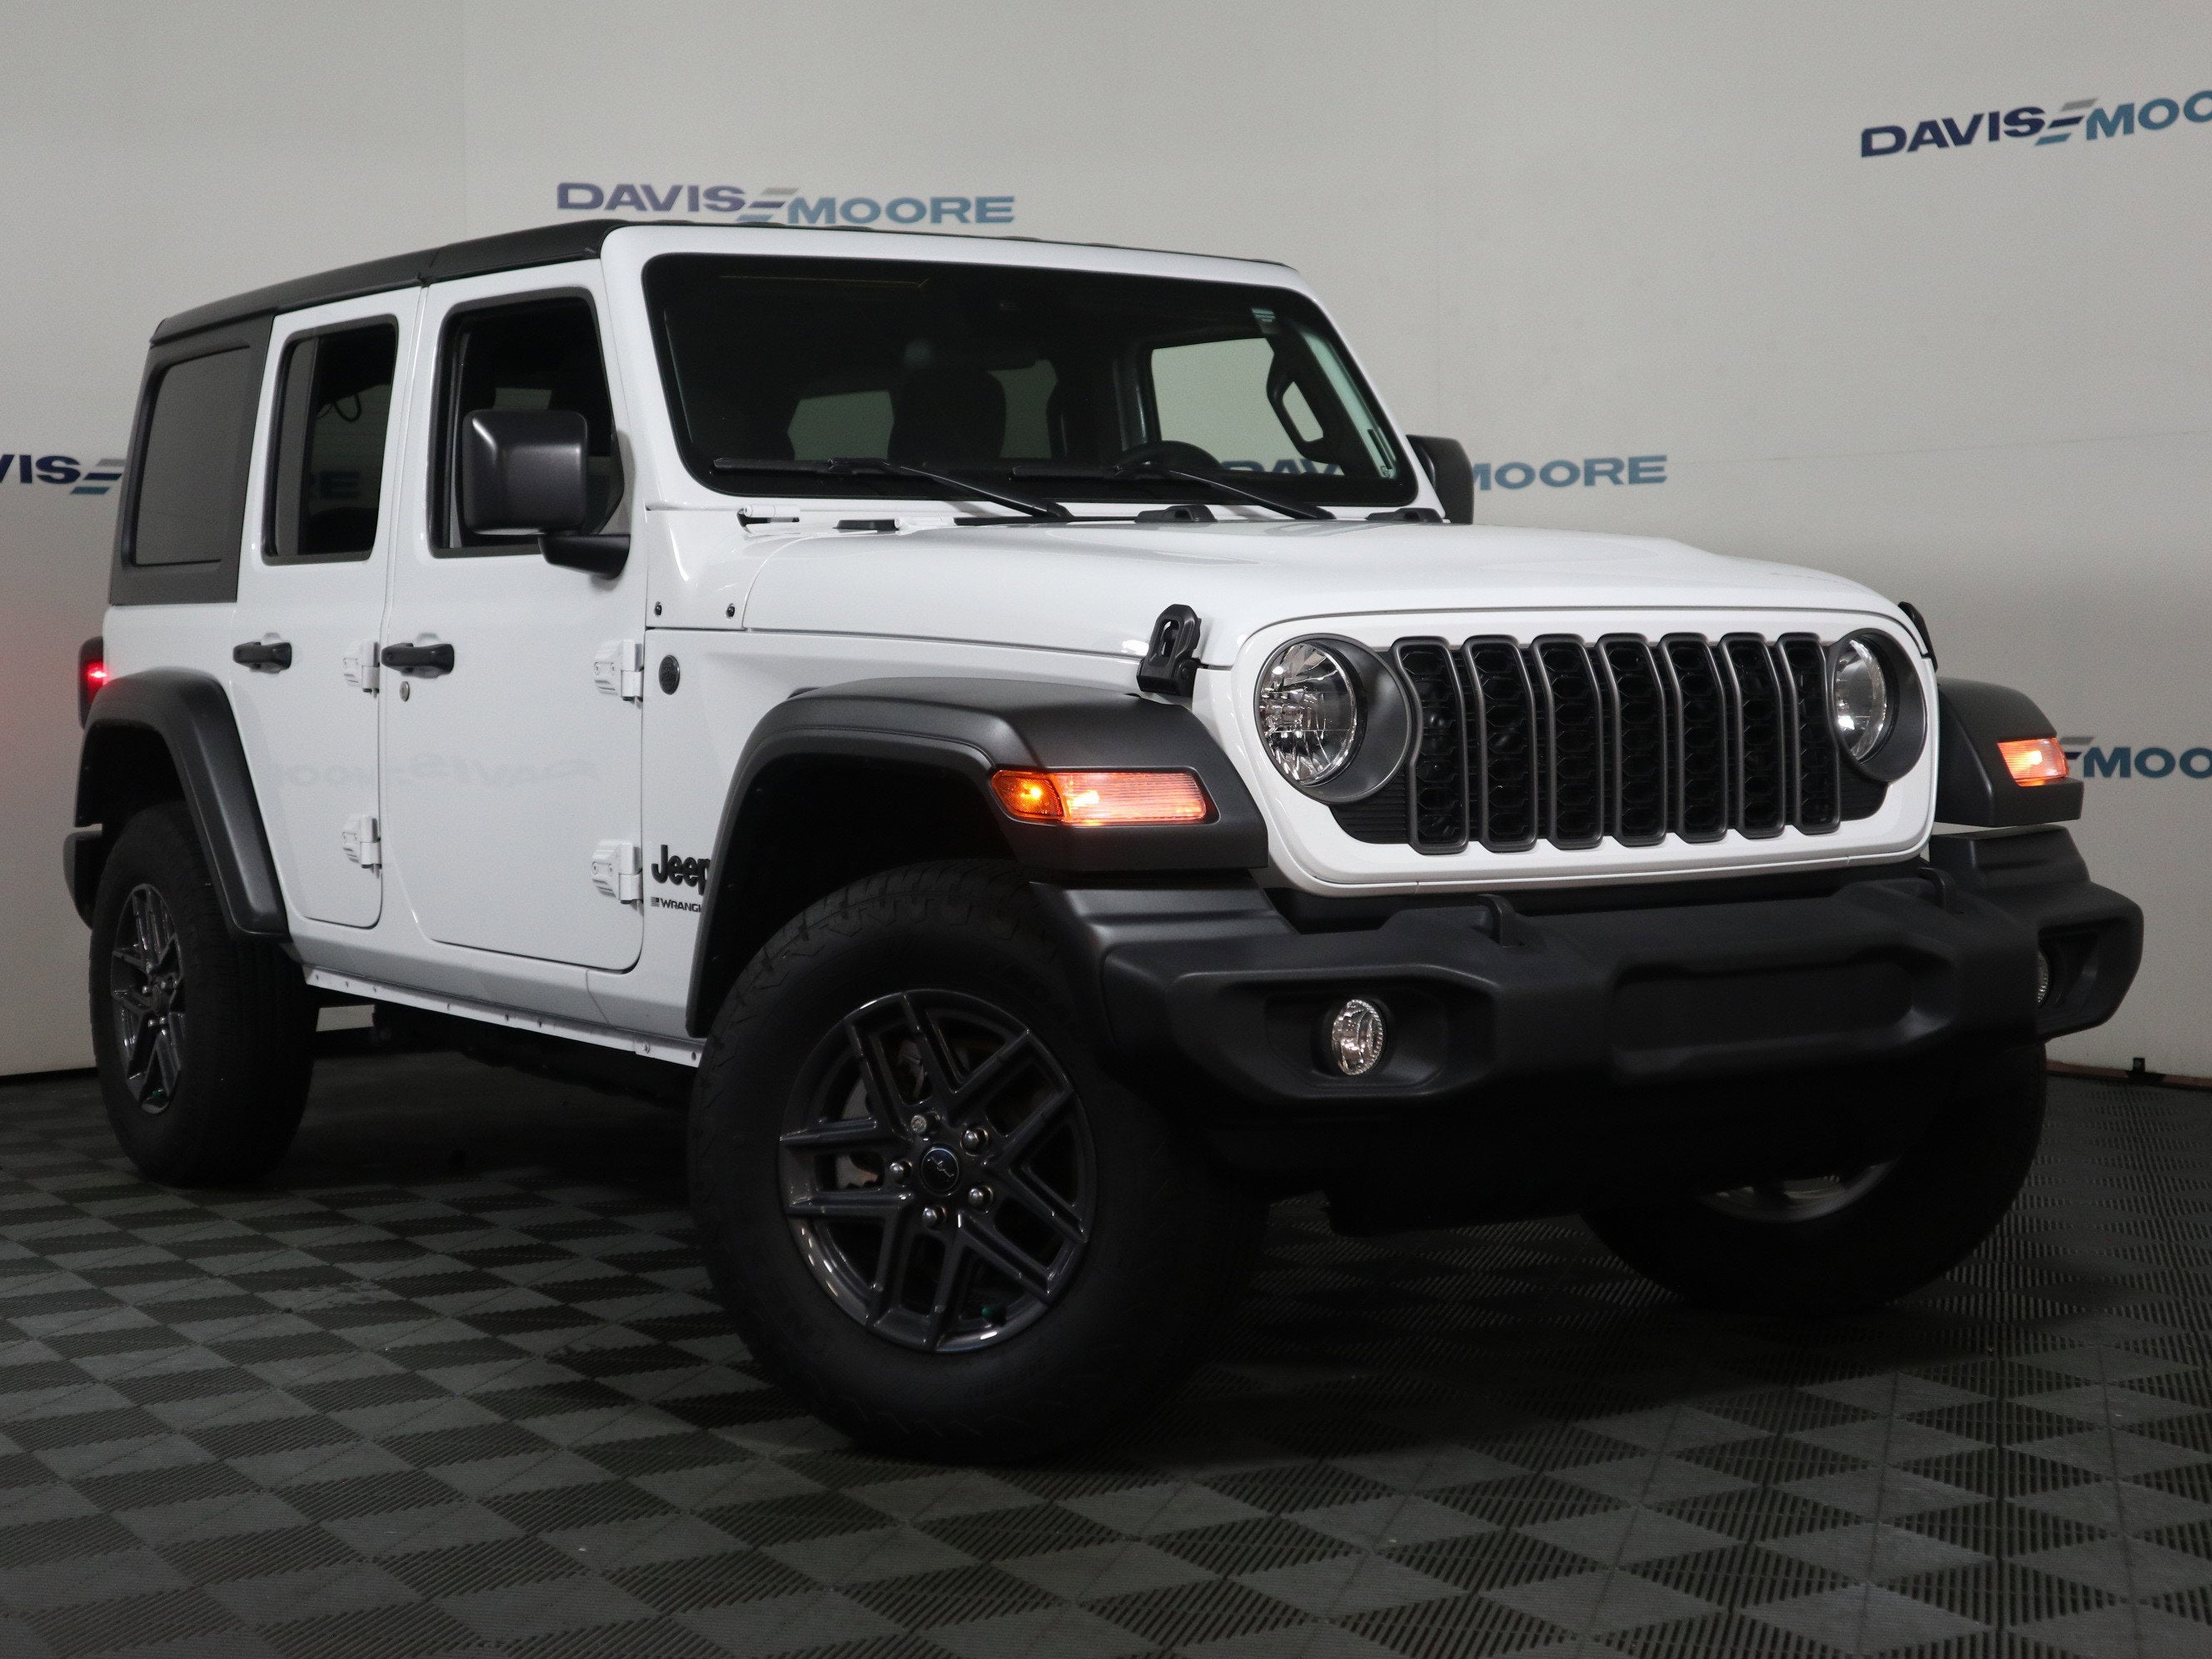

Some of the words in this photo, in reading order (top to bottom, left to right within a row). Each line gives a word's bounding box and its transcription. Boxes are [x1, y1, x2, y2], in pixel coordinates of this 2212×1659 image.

[1861, 106, 2047, 157] DAVIS
[555, 182, 746, 213] DAVIS
[787, 195, 1016, 225] MOORE
[651, 844, 711, 896] Jeep
